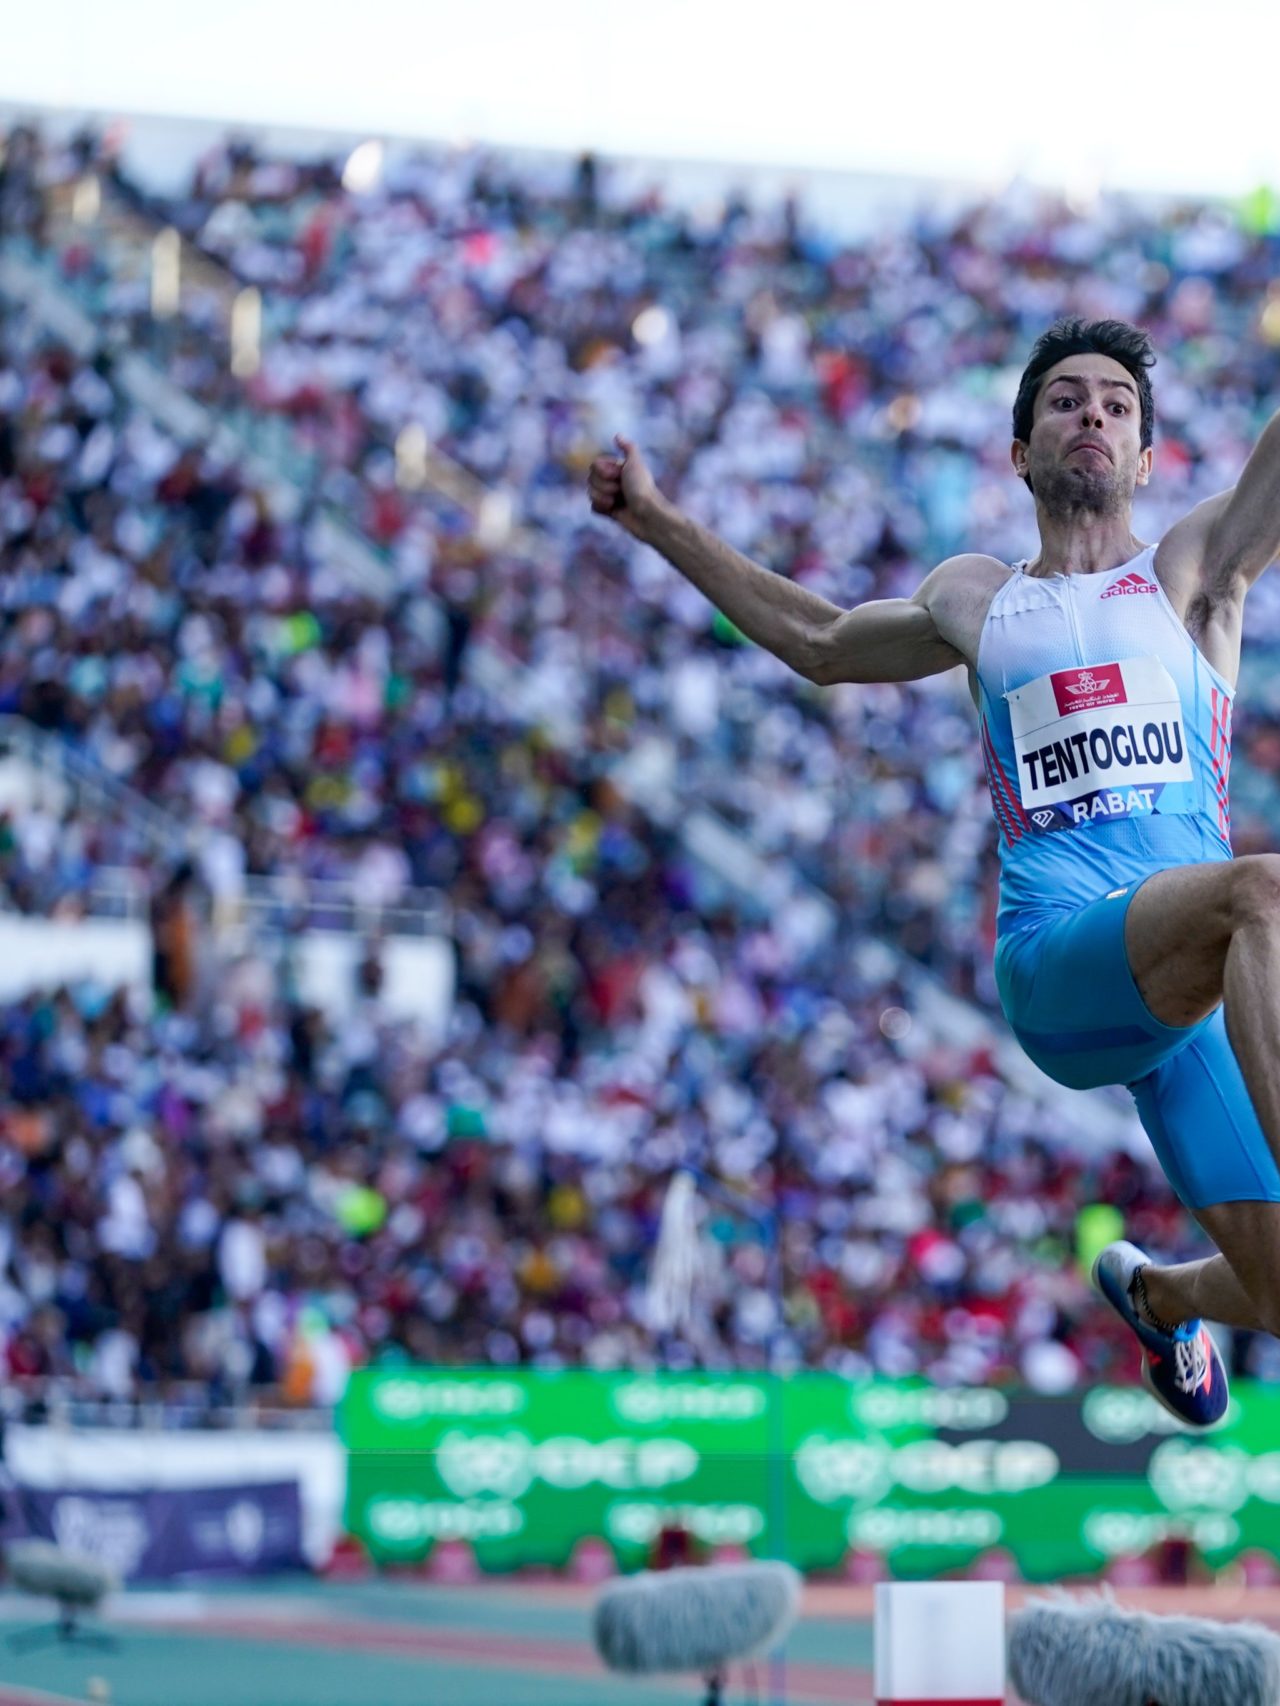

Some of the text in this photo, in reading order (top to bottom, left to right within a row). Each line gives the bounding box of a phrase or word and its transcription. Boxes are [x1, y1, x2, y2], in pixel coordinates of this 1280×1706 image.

[1100, 583, 1159, 600] adidas
[1022, 721, 1183, 790] TENTOGLOU
[1073, 789, 1155, 823] RABAT
